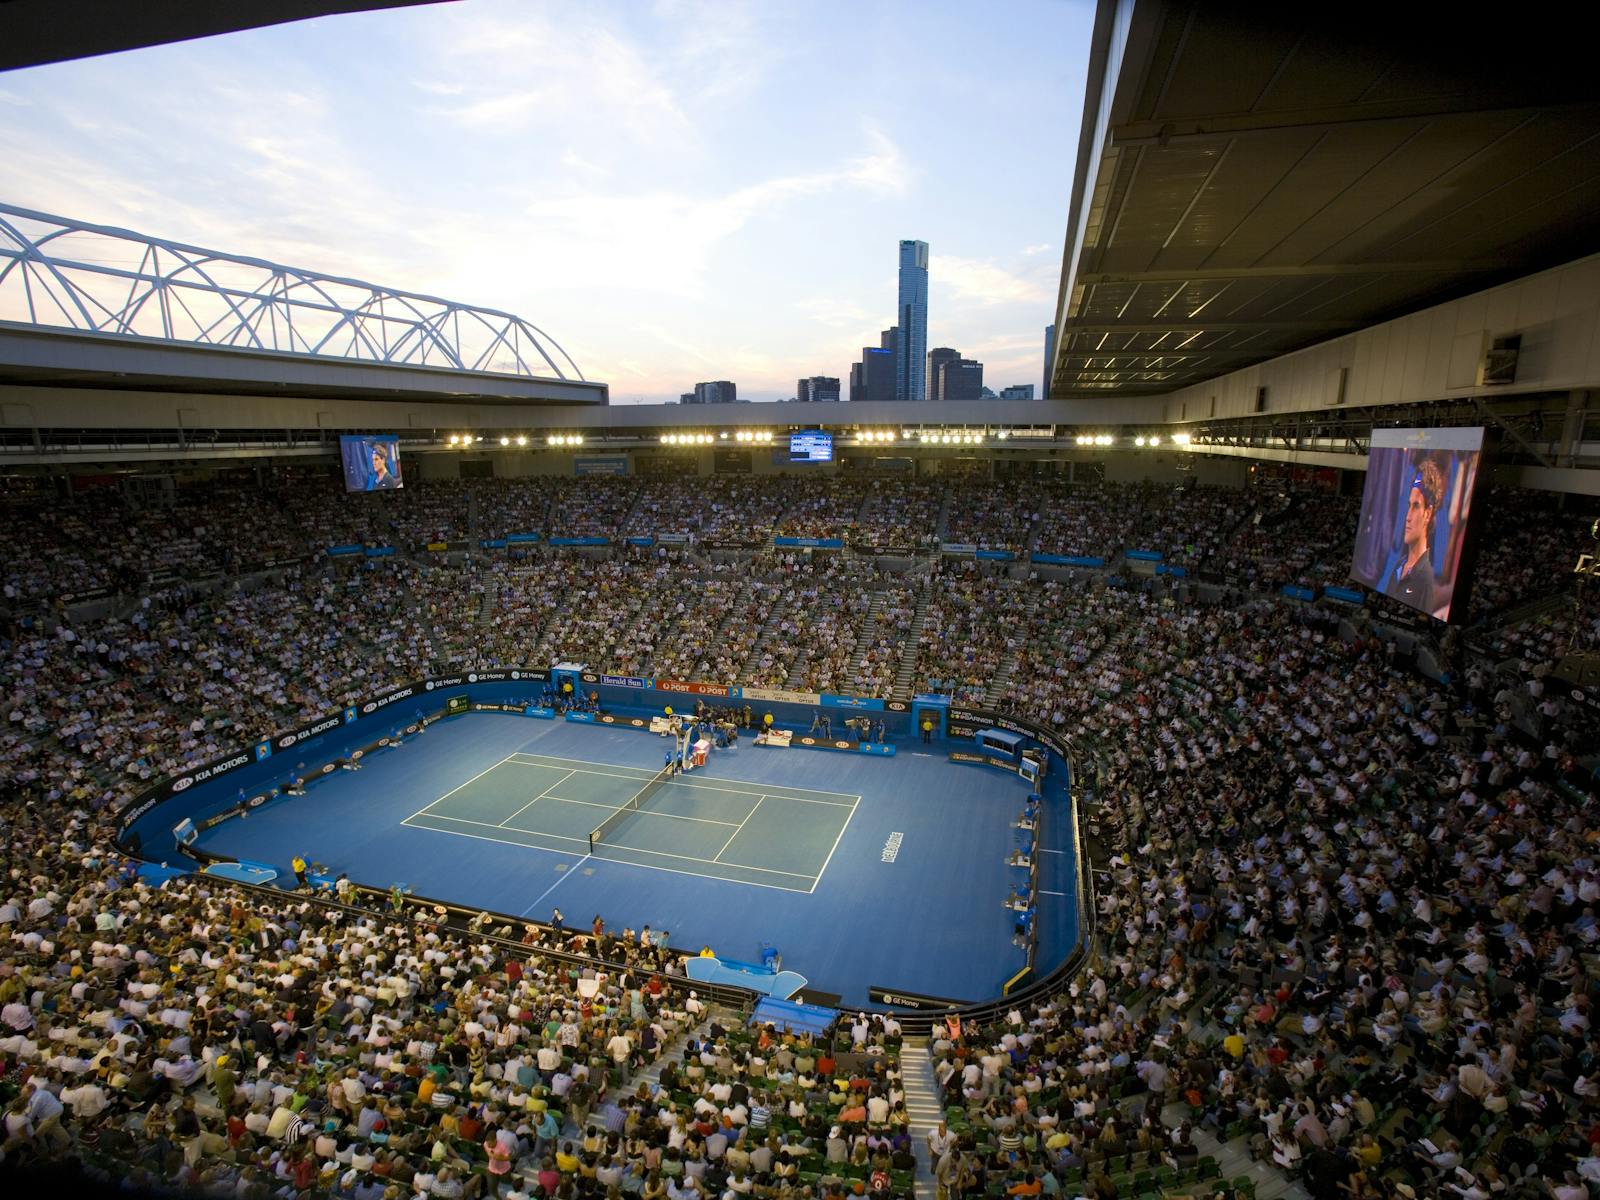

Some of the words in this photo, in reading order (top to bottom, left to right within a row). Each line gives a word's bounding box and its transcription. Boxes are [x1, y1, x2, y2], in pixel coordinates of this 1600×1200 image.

[487, 672, 505, 680] Money
[435, 680, 443, 688] GE
[443, 678, 461, 686] Money
[603, 676, 626, 686] Herald
[628, 679, 641, 687] Sun
[671, 684, 690, 692] POST
[707, 687, 727, 696] POST
[378, 698, 388, 707] KIA
[388, 688, 413, 703] MOTORS
[297, 730, 310, 740] KIA
[311, 718, 339, 735] MOTORS
[195, 770, 211, 782] KIA
[213, 754, 248, 775] MOTORS
[901, 999, 920, 1009] Money
